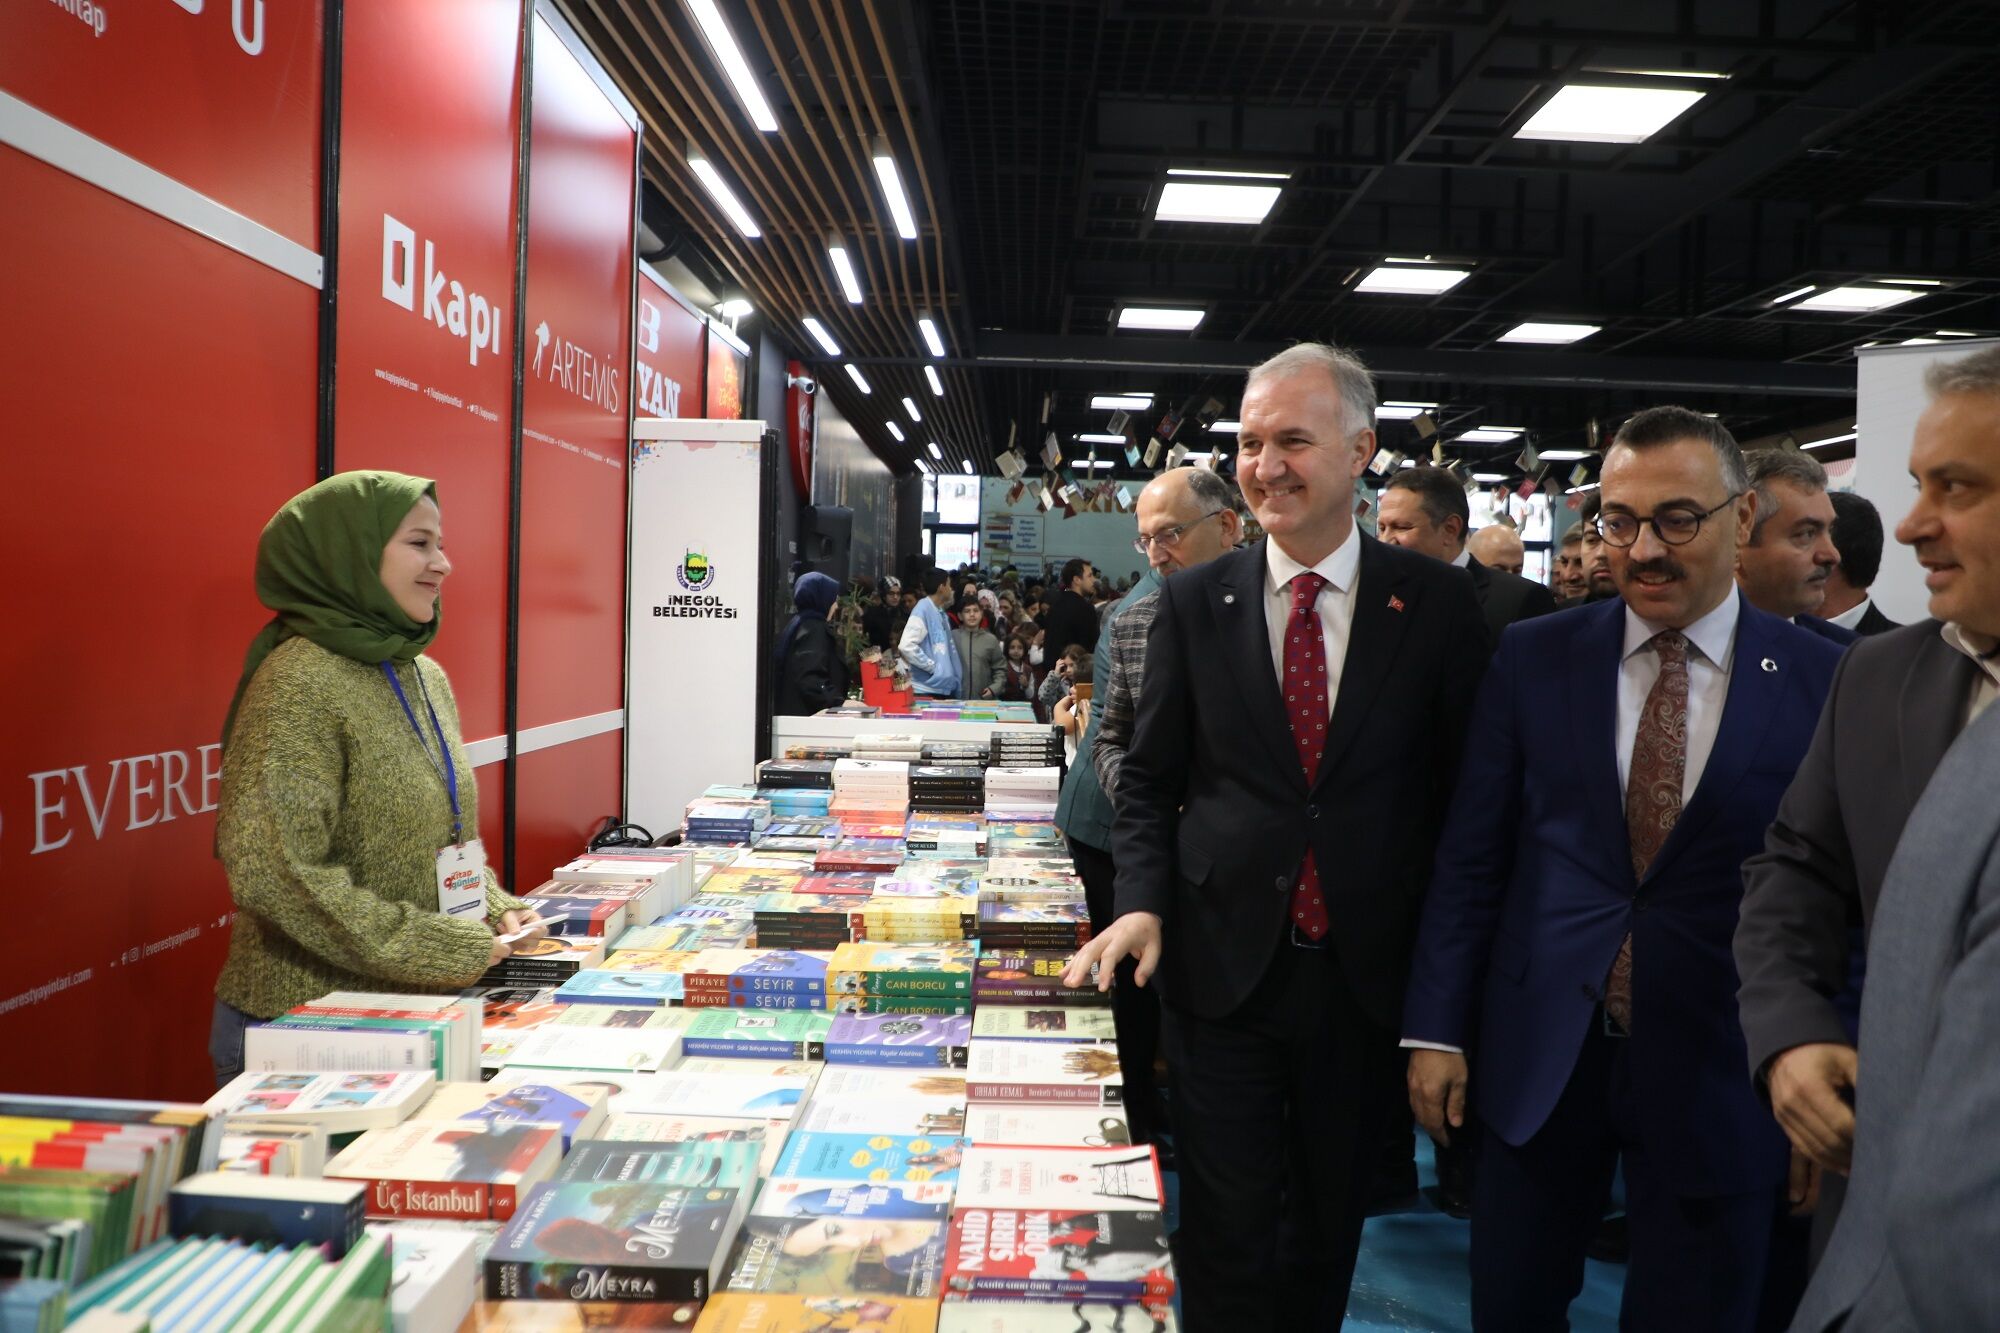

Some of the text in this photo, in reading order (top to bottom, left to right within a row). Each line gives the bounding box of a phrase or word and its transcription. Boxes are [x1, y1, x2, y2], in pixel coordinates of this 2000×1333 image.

[668, 594, 724, 607] İNEGÖL
[653, 606, 738, 619] BELEDİYESİ
[689, 977, 795, 991] PİRAYE SEYİR
[885, 980, 946, 990] CAN BORCU
[691, 993, 797, 1008] PİRAYE SEYİR
[885, 1006, 946, 1015] CAN BORCU
[974, 1086, 997, 1097] ORHAN
[999, 1087, 1024, 1098] KEMAL
[376, 1180, 482, 1214] Üç İstanbul
[625, 1188, 685, 1260] MEYRA
[955, 1210, 990, 1272] NAHİD
[988, 1210, 1017, 1263] SIRRI
[1016, 1212, 1050, 1259] ÖRİK
[569, 1267, 658, 1301] MEYRA
